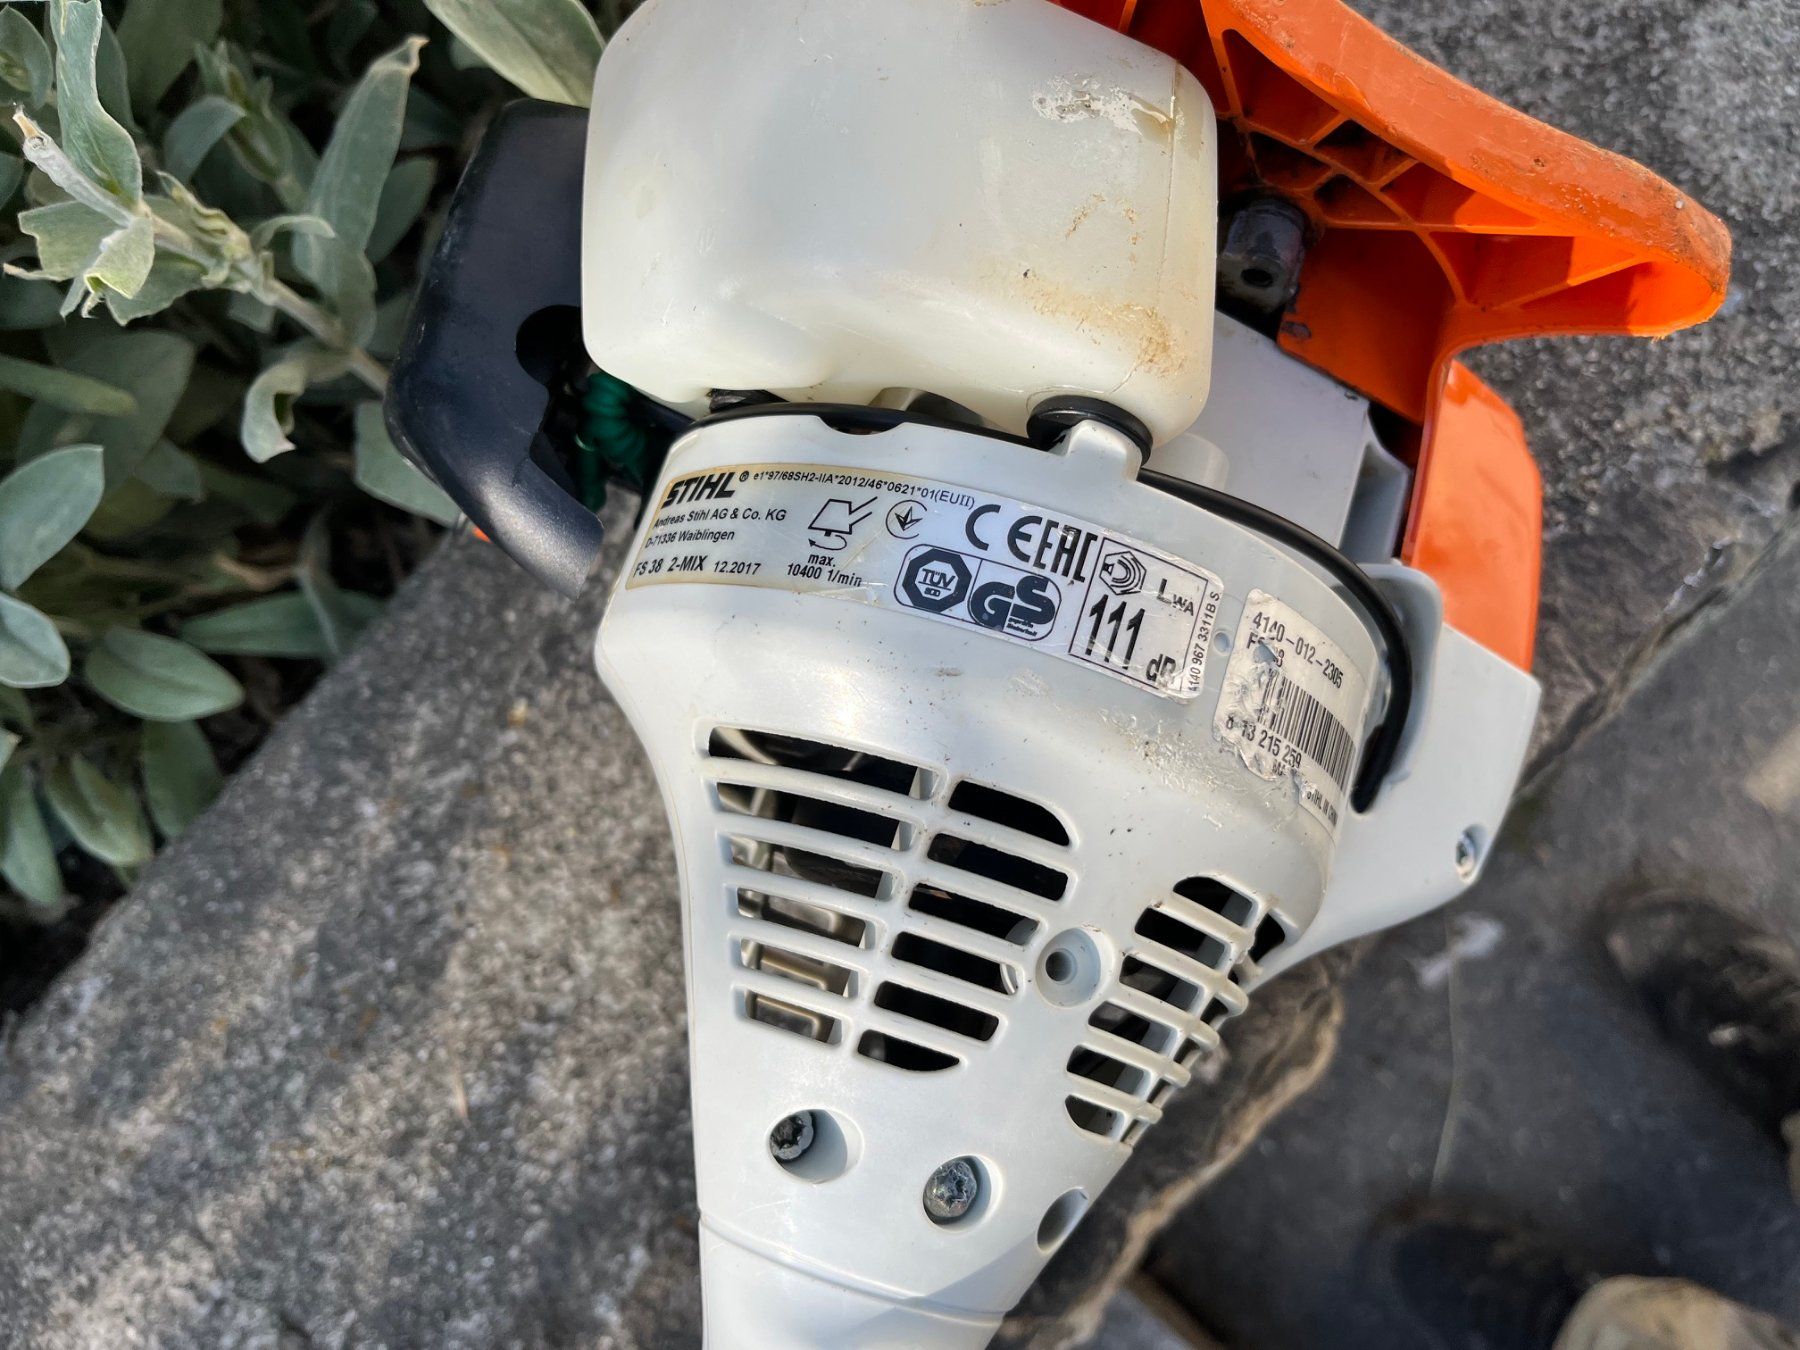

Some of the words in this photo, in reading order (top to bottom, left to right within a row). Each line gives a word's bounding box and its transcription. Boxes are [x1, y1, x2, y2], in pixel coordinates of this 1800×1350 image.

[661, 472, 735, 509] STIHL
[653, 514, 685, 528] Andreas
[687, 508, 710, 521] Stihl
[710, 508, 728, 521] AG
[729, 507, 739, 519] &
[742, 508, 761, 521] Co.
[765, 508, 787, 521] KG
[645, 532, 677, 548] D-71336
[678, 529, 735, 543] Waiblingen
[633, 561, 648, 578] FS
[648, 558, 664, 574] 38
[667, 555, 708, 573] 2-MIX
[713, 561, 762, 576] 12.2017
[808, 553, 836, 568] max.
[787, 563, 822, 580] 10400
[827, 569, 862, 587] 1/min
[922, 568, 956, 588] TÜV
[967, 575, 1057, 633] GS
[1088, 593, 1146, 671] 111
[1191, 643, 1206, 665] 967
[1258, 729, 1282, 756] 215
[1282, 744, 1302, 768] 259
